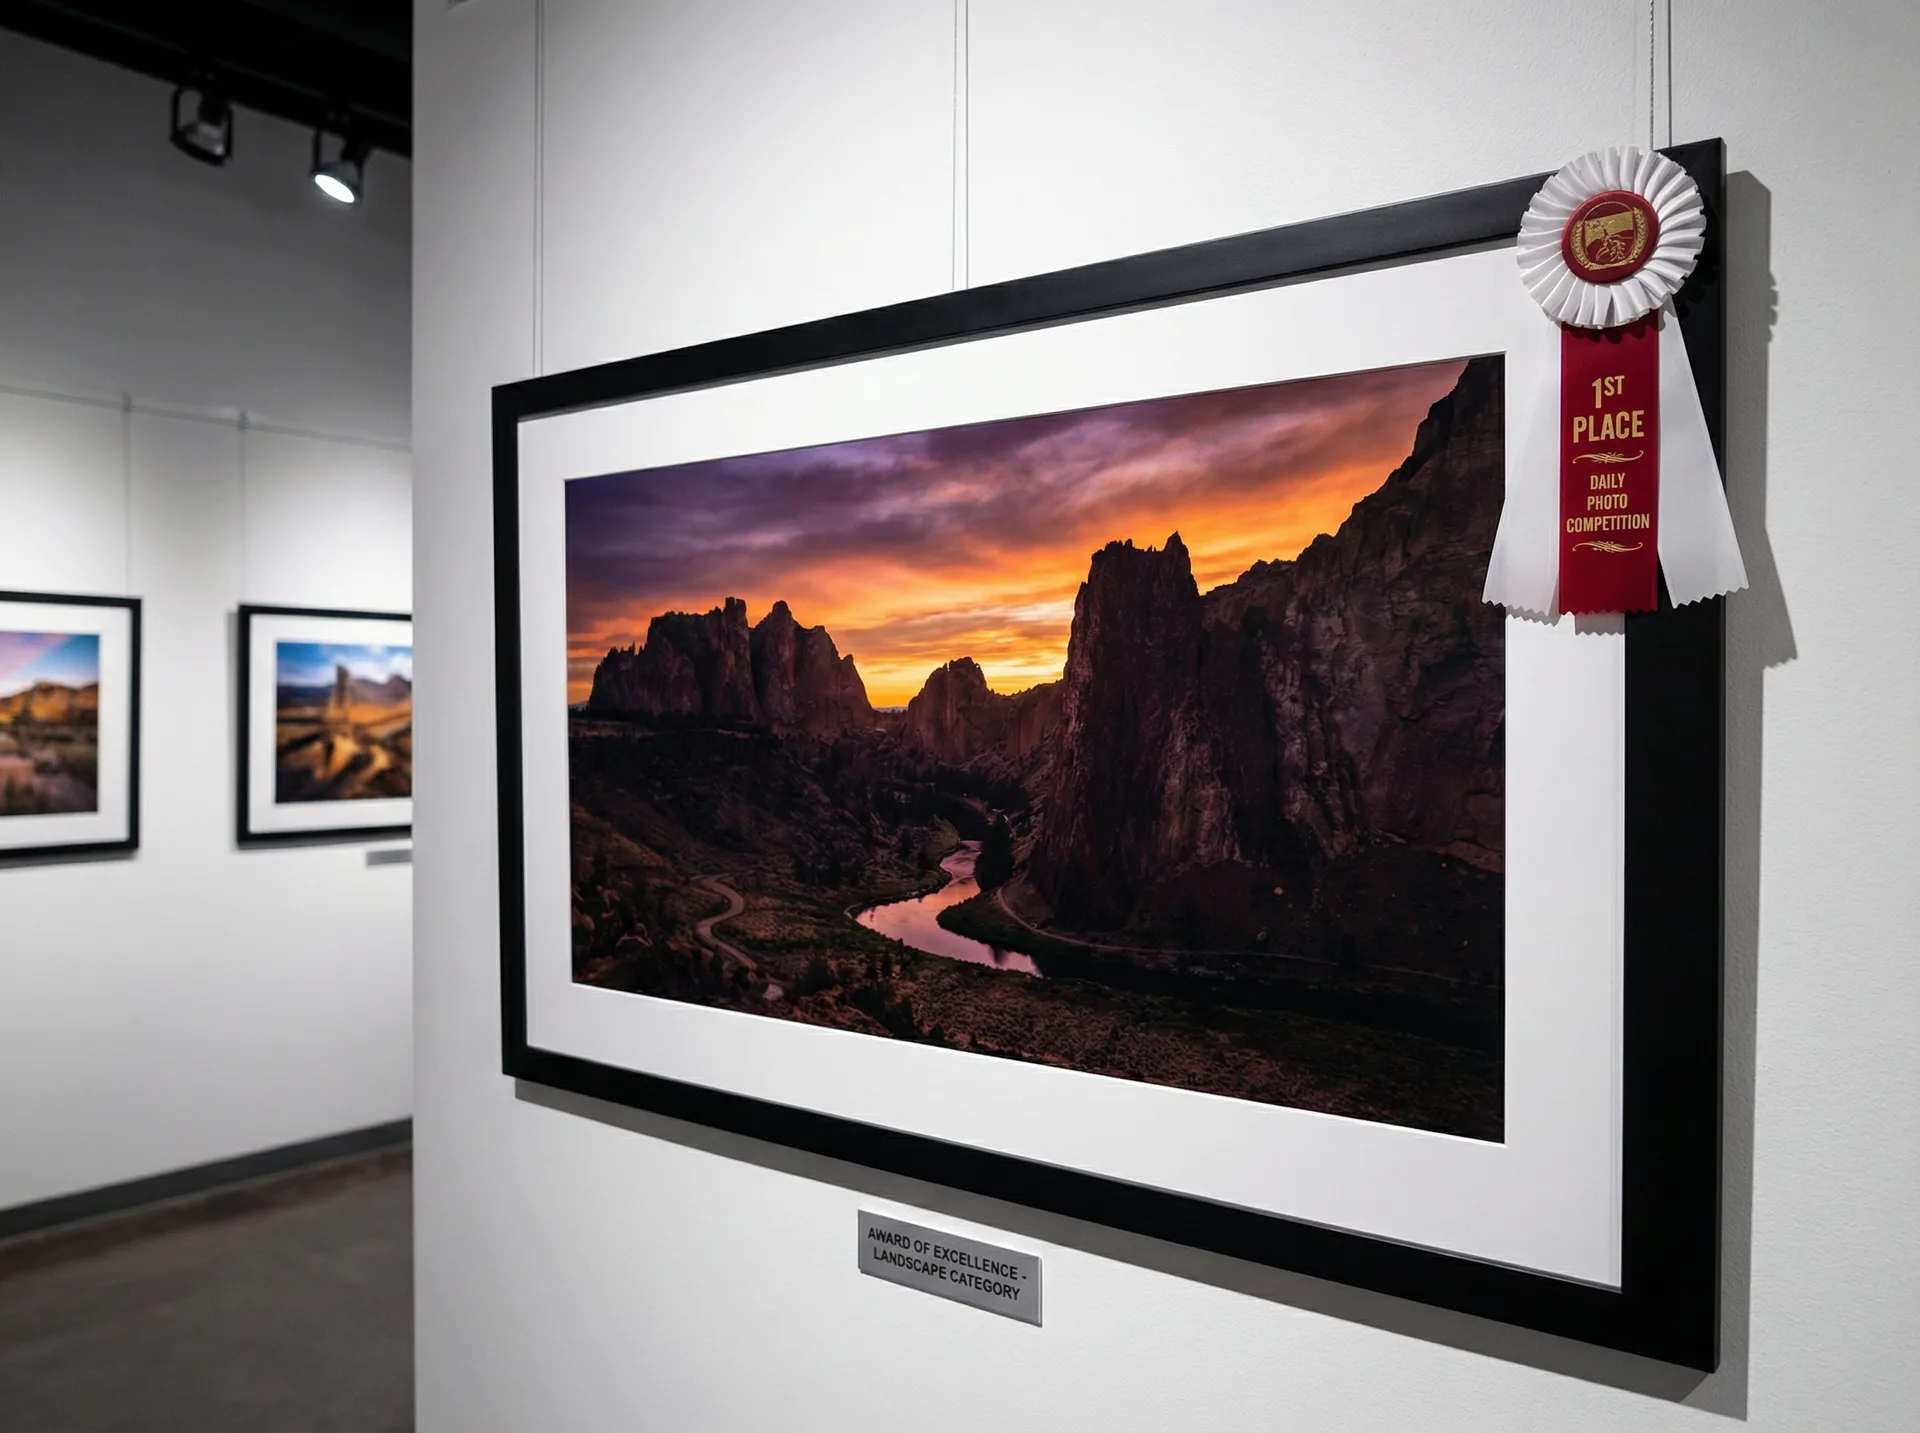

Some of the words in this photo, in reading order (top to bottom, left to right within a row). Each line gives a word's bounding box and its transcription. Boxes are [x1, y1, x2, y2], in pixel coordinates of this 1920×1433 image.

[1592, 375, 1625, 409] 1ST
[1573, 410, 1644, 443] PLACE
[1590, 473, 1625, 490] DAILY
[1587, 493, 1628, 511] PHOTO
[1566, 513, 1650, 533] COMPETITION
[868, 1228, 911, 1249] AWARD
[914, 1240, 930, 1254] OF
[934, 1245, 1018, 1280] EXCELLENCE
[874, 1247, 947, 1280] LANDSCAPE
[950, 1270, 1020, 1300] CATEGORY
